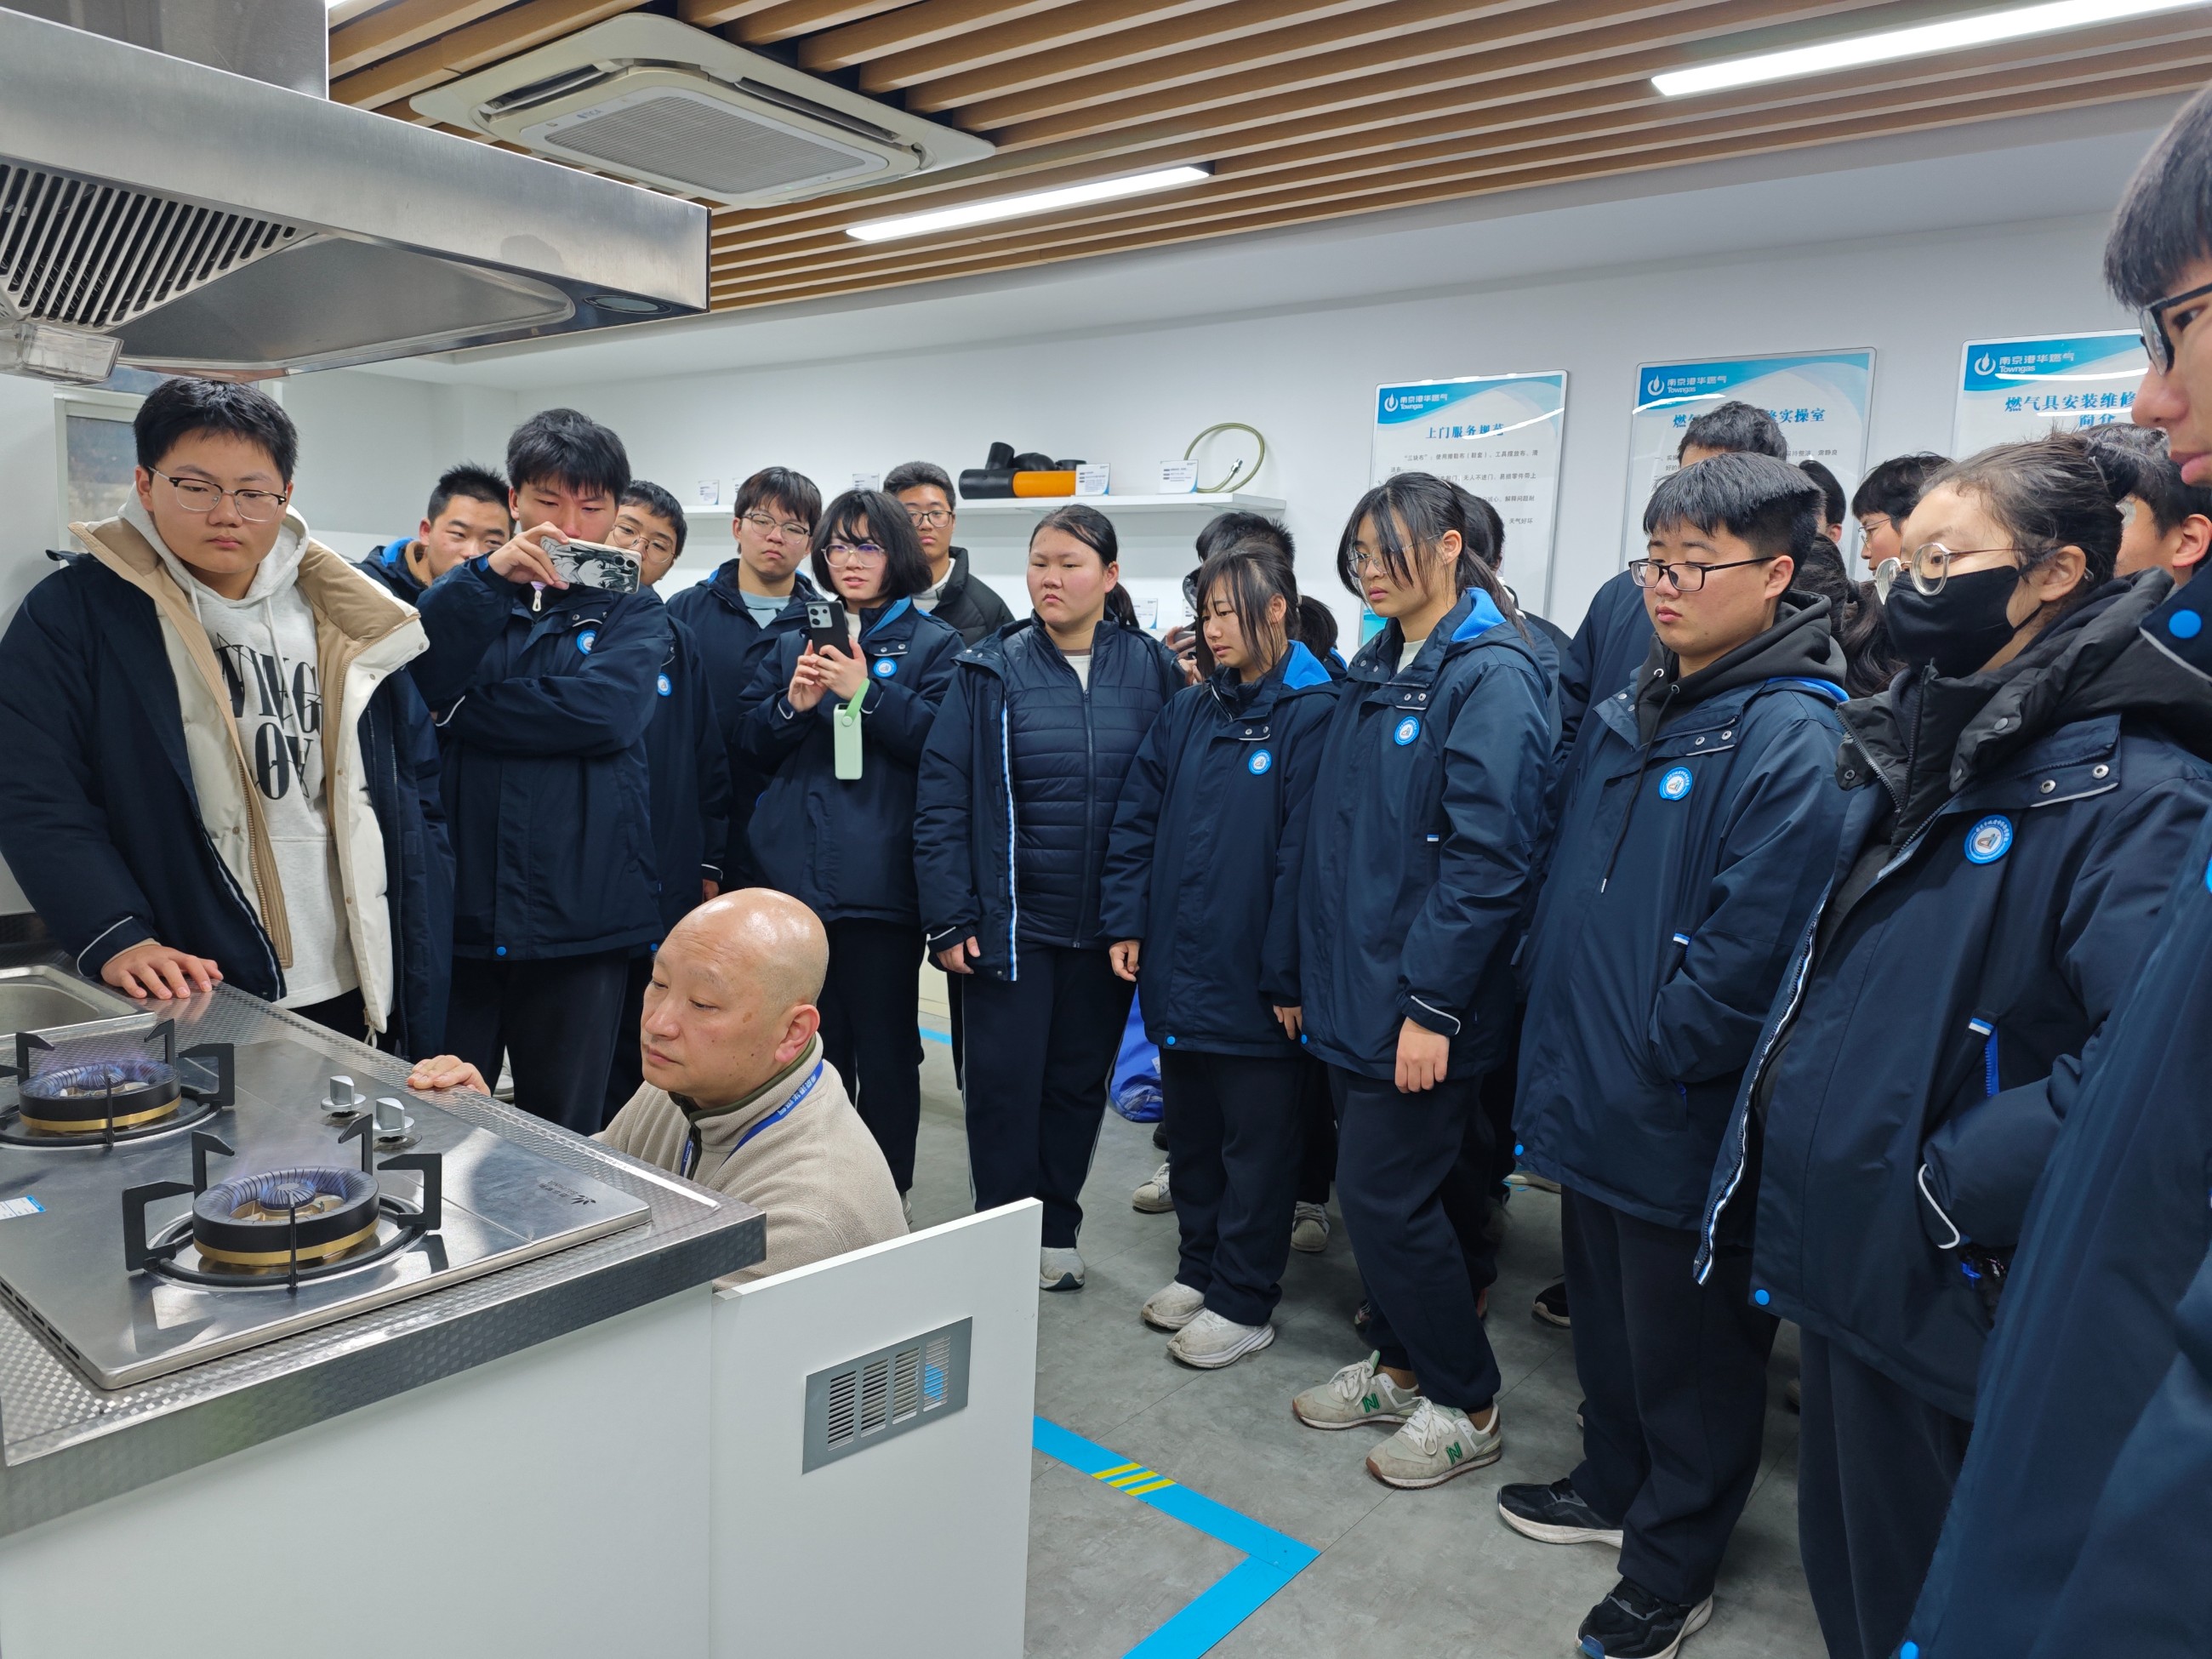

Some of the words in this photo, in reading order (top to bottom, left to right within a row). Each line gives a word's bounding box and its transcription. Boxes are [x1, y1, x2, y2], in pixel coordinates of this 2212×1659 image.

[1998, 351, 2074, 365] 南京港华燃气
[1999, 365, 2036, 373] Towngas
[1667, 375, 1727, 386] 南京港华燃气
[2005, 391, 2136, 412] 燃气具安装维修
